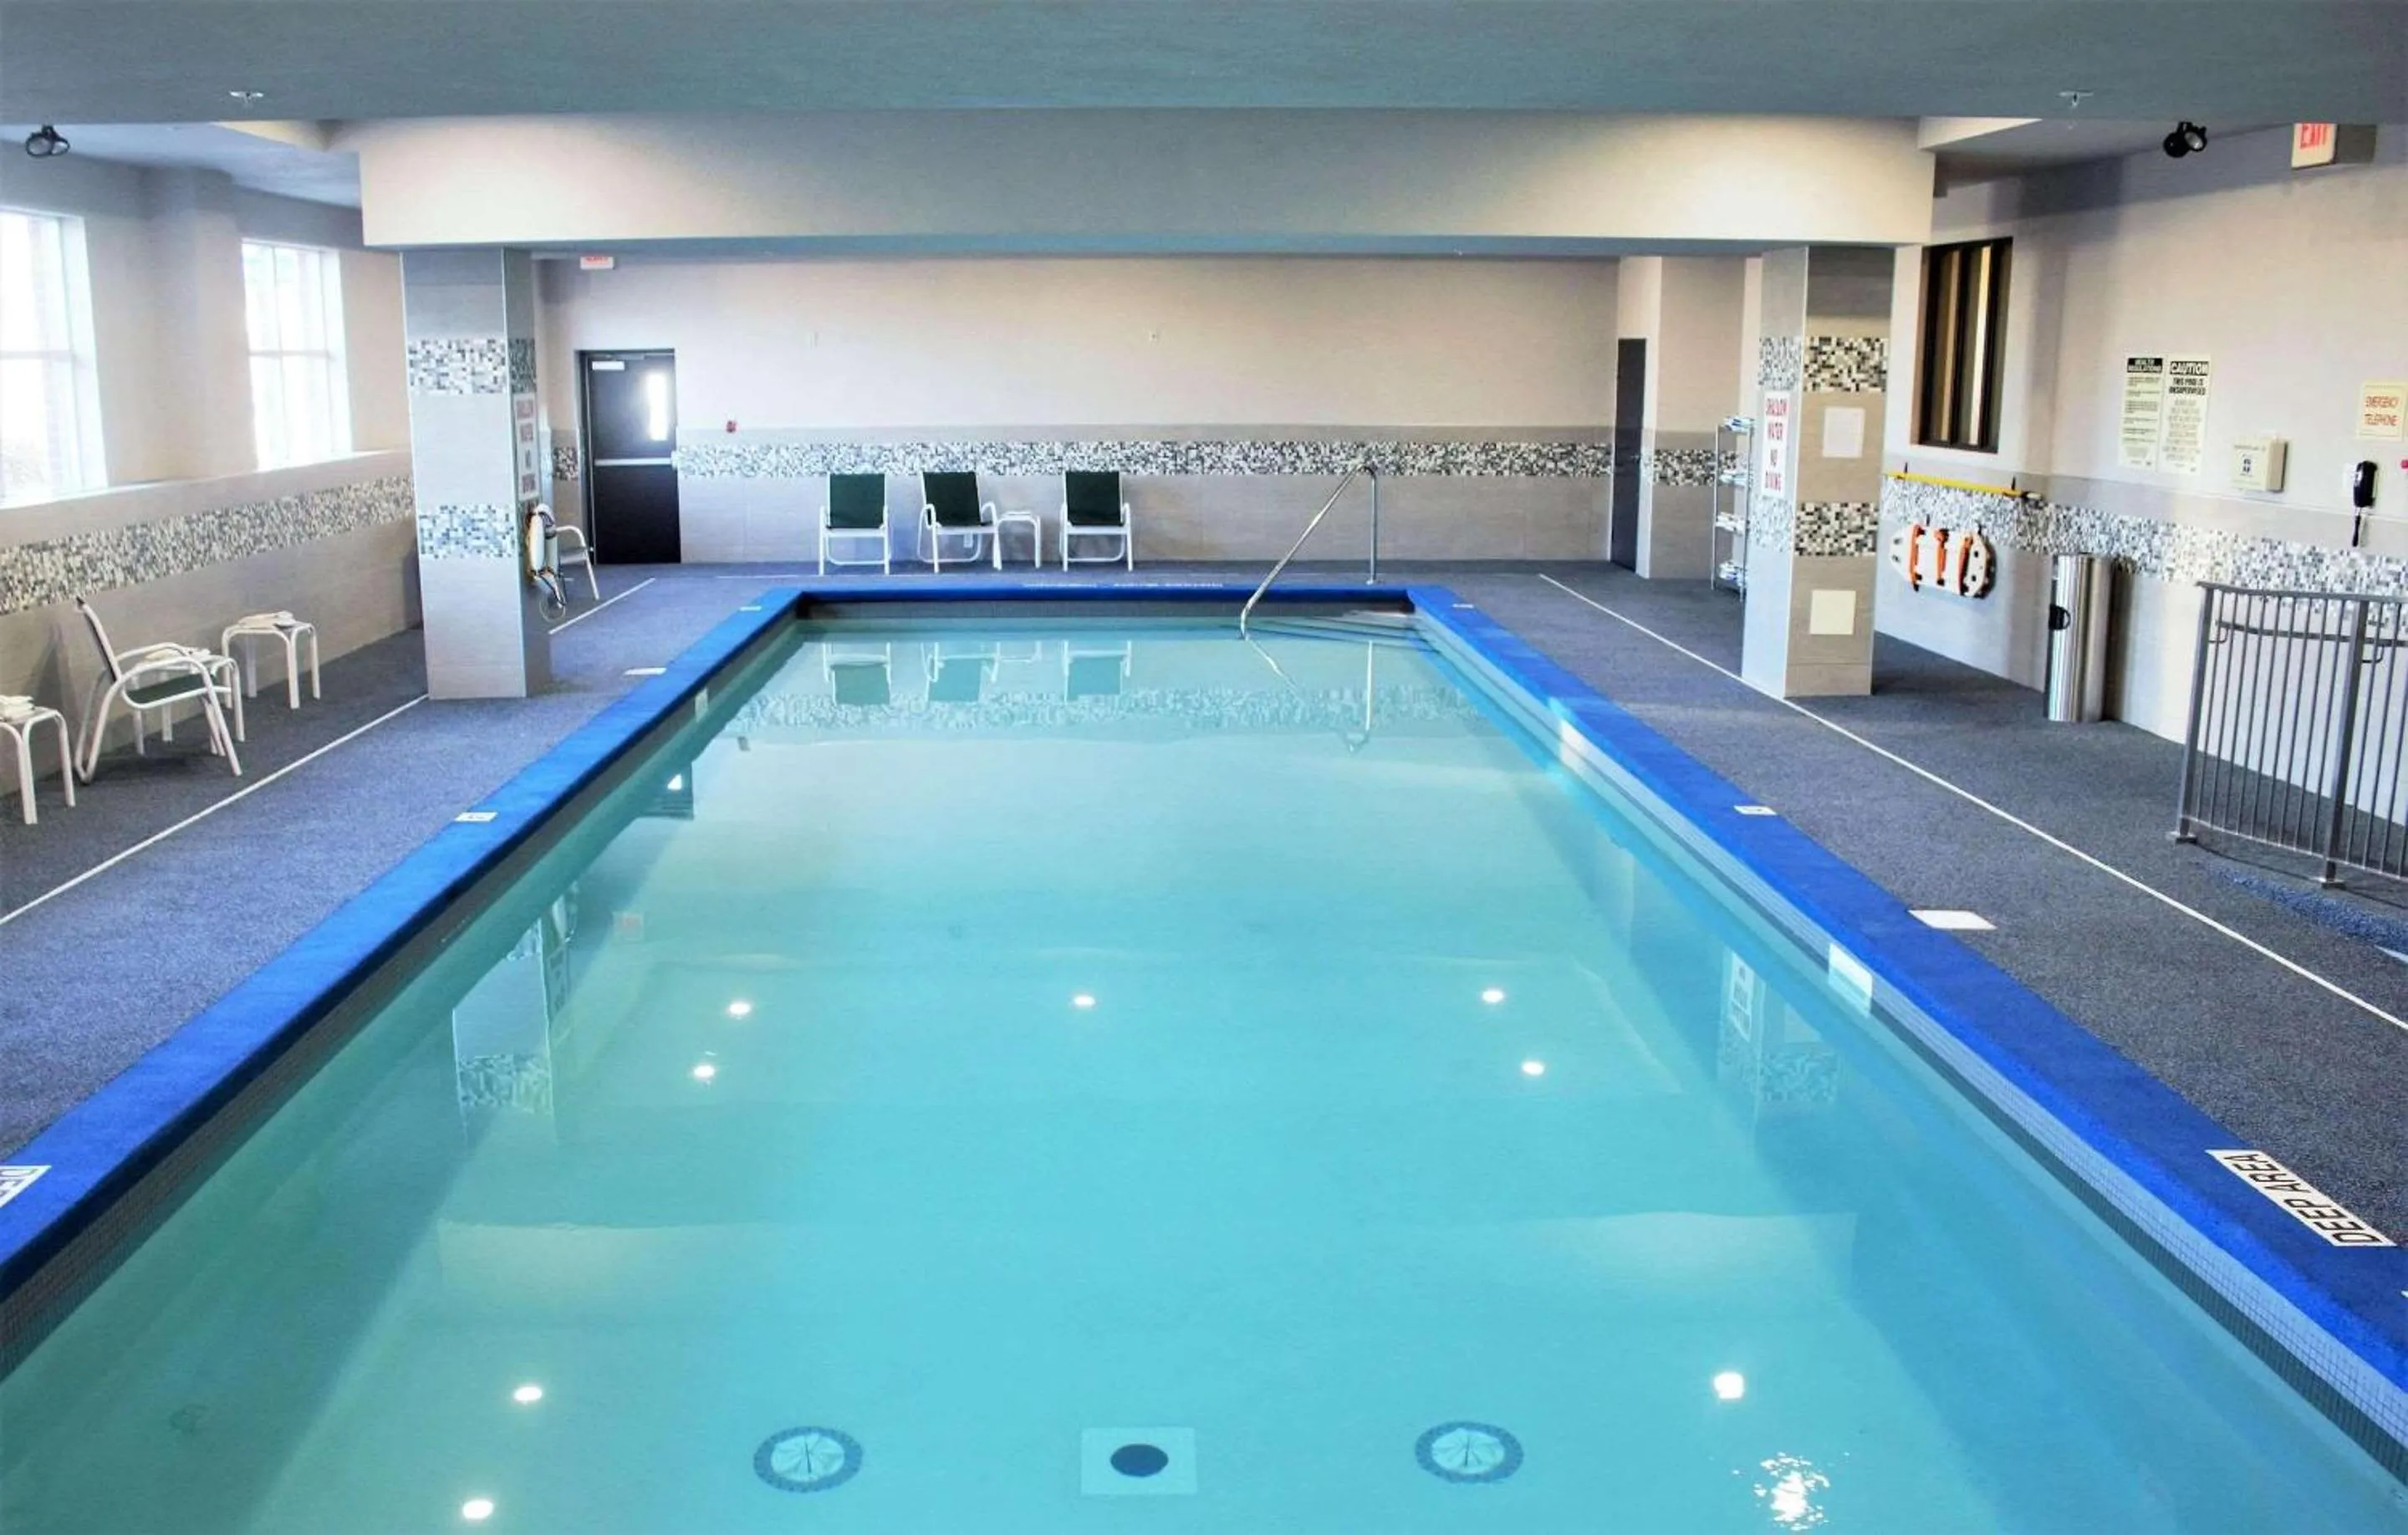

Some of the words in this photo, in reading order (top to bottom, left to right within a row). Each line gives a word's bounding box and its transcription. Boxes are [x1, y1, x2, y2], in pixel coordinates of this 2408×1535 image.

[2299, 123, 2329, 149] EXIT
[2171, 361, 2208, 375] CAUTION
[2173, 377, 2184, 385] THIS
[2185, 378, 2196, 386] POOL
[2169, 386, 2206, 395] UNSUPERVISED
[2365, 395, 2400, 409] EMERGENCY
[2365, 413, 2398, 426] TELEPHONE
[1767, 421, 1783, 441] WATER
[1765, 471, 1782, 492] DIVING
[2222, 1153, 2311, 1194] AREA
[2283, 1197, 2383, 1243] DEEP
